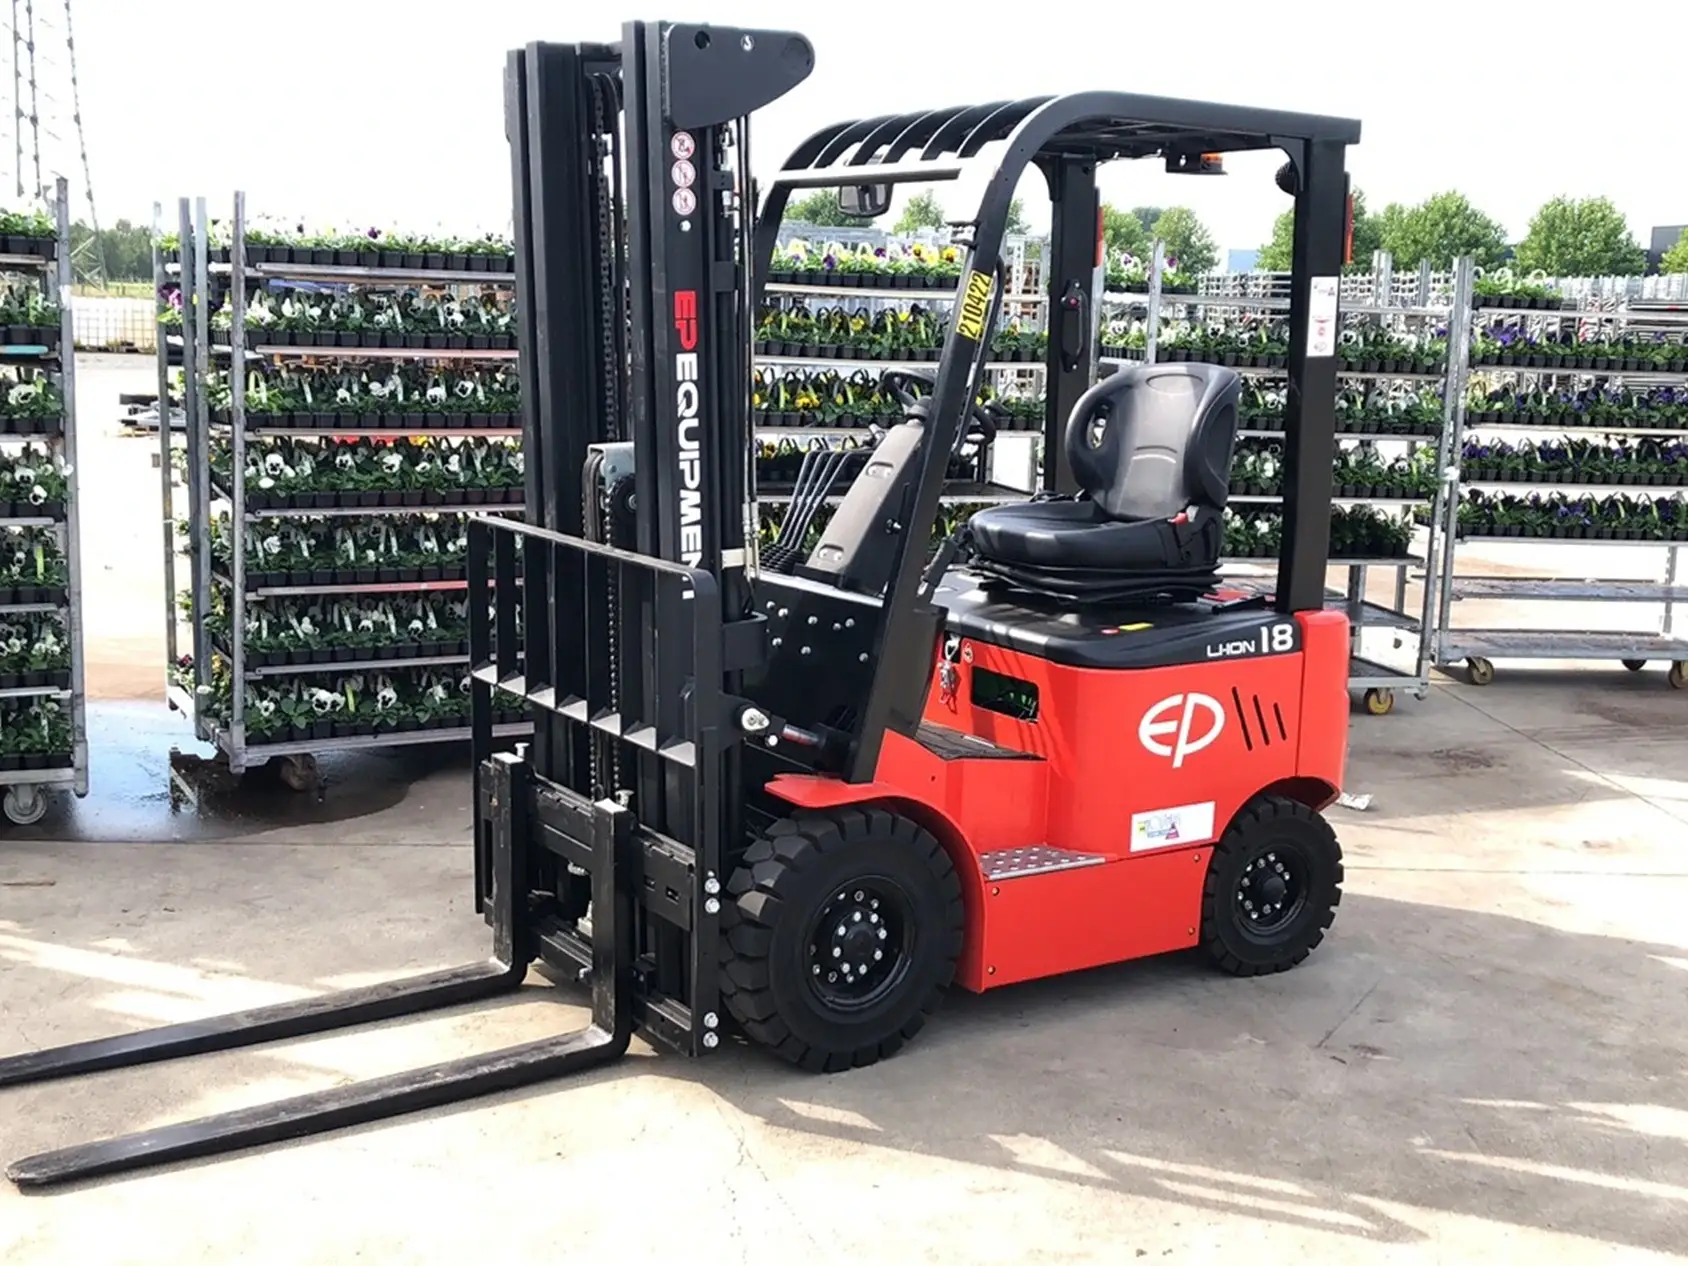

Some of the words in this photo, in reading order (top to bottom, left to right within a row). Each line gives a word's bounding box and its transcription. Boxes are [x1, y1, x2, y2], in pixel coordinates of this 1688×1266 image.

[674, 291, 697, 351] EP
[959, 272, 991, 338] 210422
[1260, 623, 1294, 653] 18
[1138, 692, 1226, 768] EP
